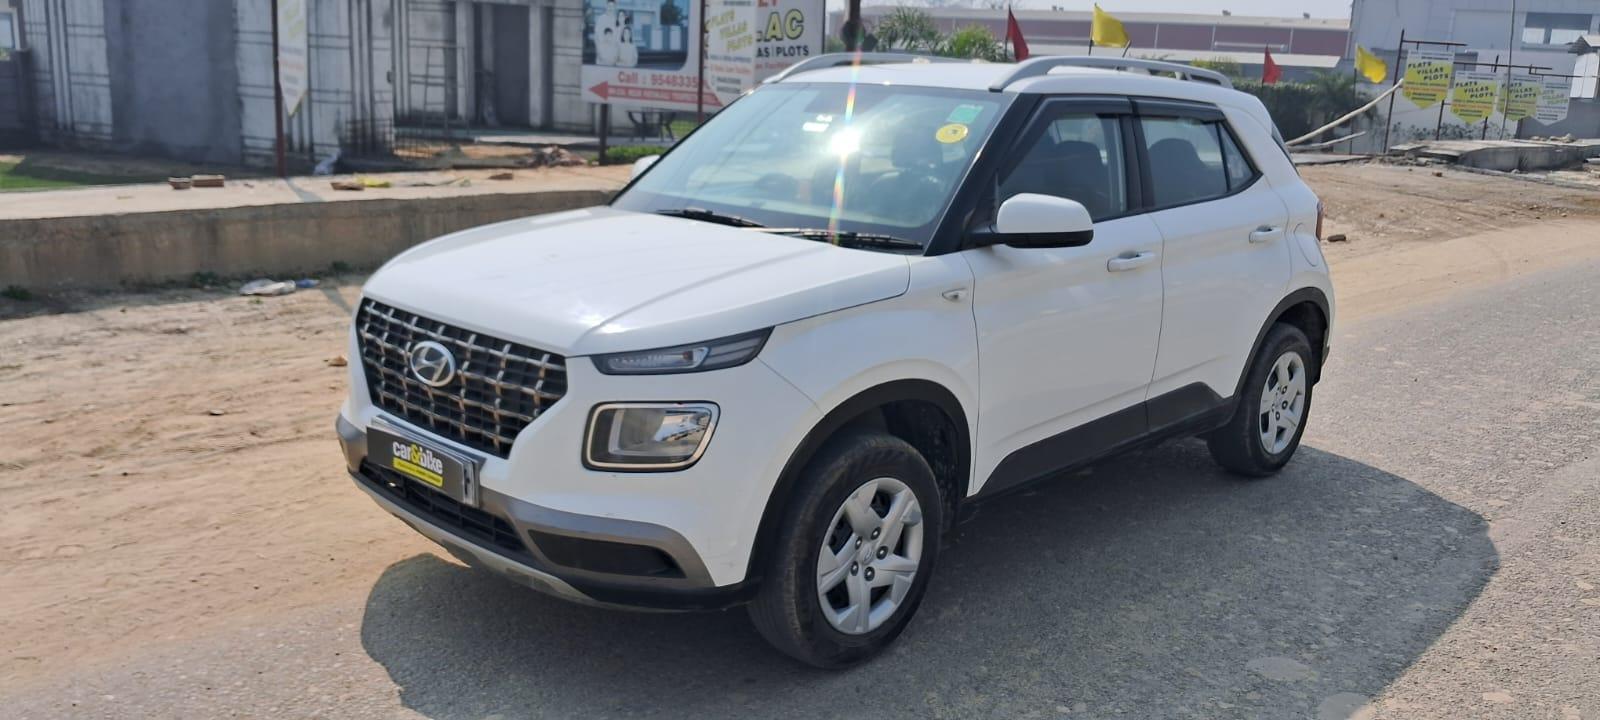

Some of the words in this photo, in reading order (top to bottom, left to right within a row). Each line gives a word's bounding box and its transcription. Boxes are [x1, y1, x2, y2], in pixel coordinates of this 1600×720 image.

[756, 8, 804, 42] AC
[756, 47, 769, 57] AS
[776, 45, 809, 57] PLOTS
[1408, 61, 1432, 69] FLATS
[1416, 66, 1444, 75] VILLAS
[617, 71, 639, 83] Call
[651, 73, 698, 88] 9548335
[1455, 80, 1478, 88] FLATS
[392, 441, 443, 474] car&bike
